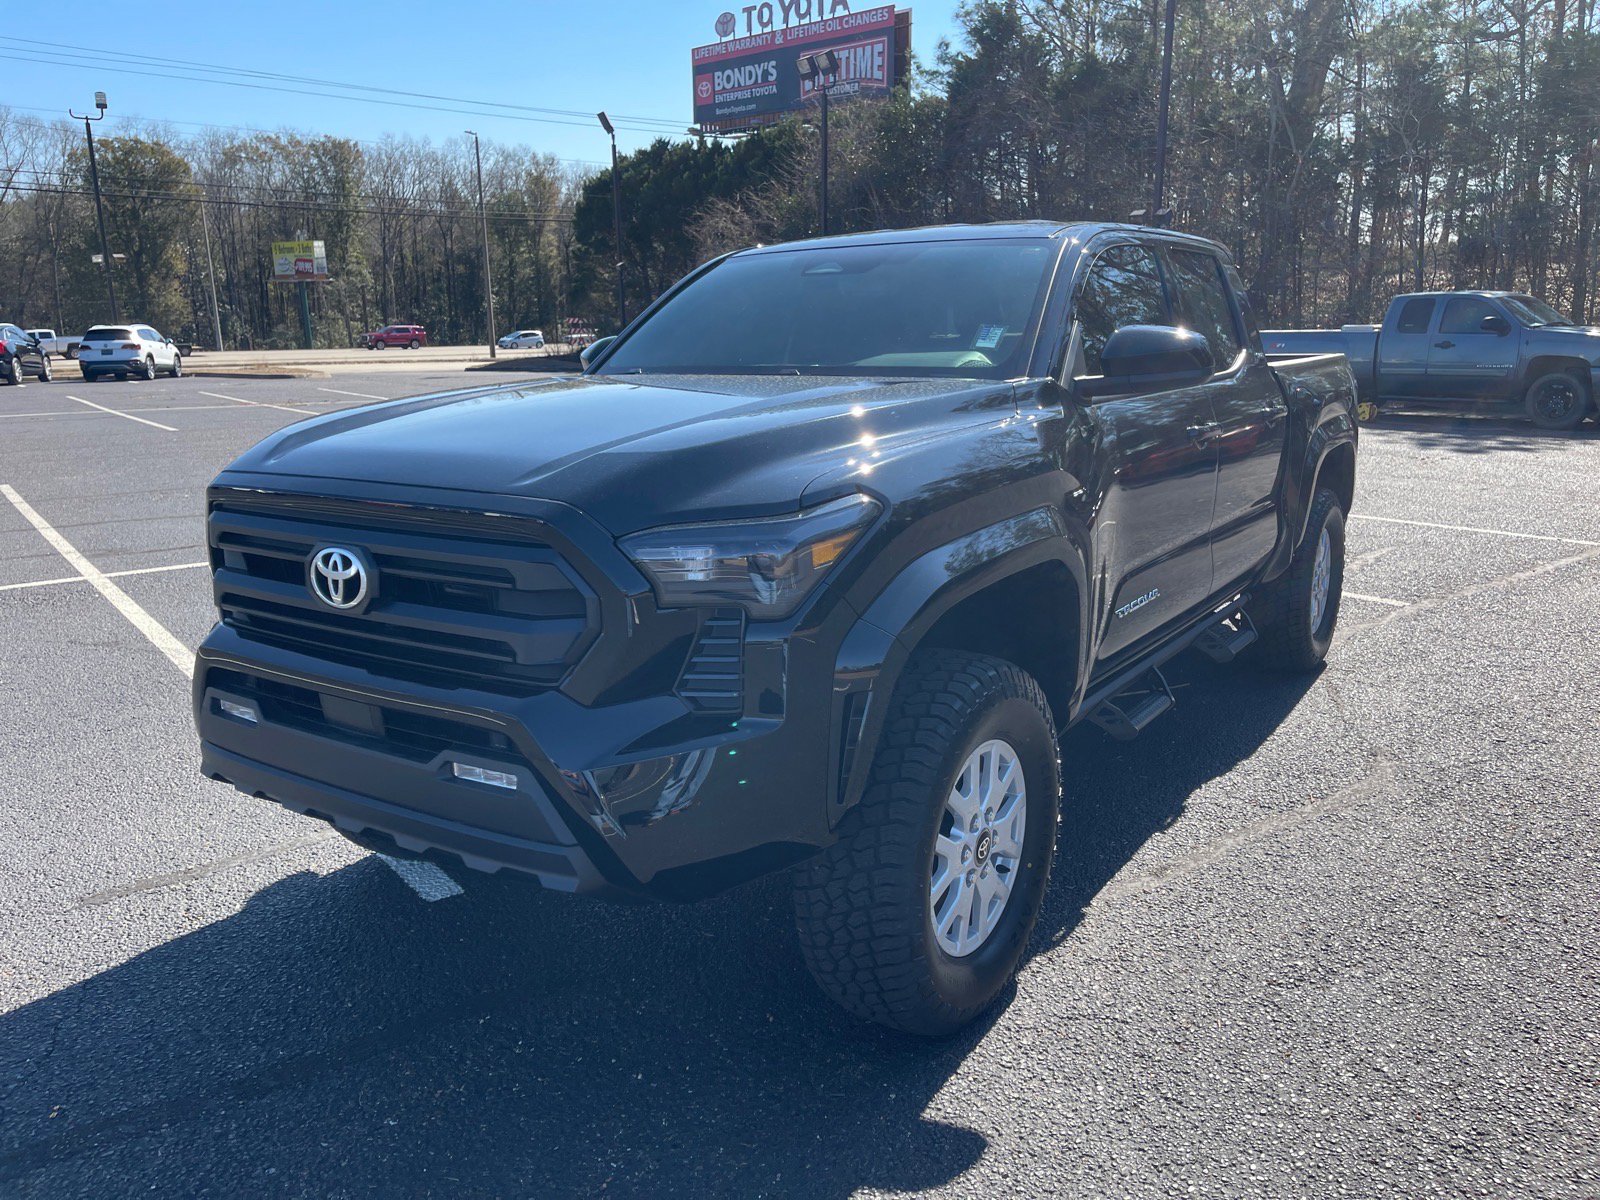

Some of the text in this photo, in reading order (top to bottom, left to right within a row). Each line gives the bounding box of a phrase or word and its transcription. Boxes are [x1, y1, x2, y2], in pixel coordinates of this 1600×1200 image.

[695, 8, 889, 59] LIFETIME WARRANTY & LIFETIME OIL CHANGES
[714, 60, 777, 91] BONDY'S
[715, 84, 777, 103] ENTERPRISE TOYOTA
